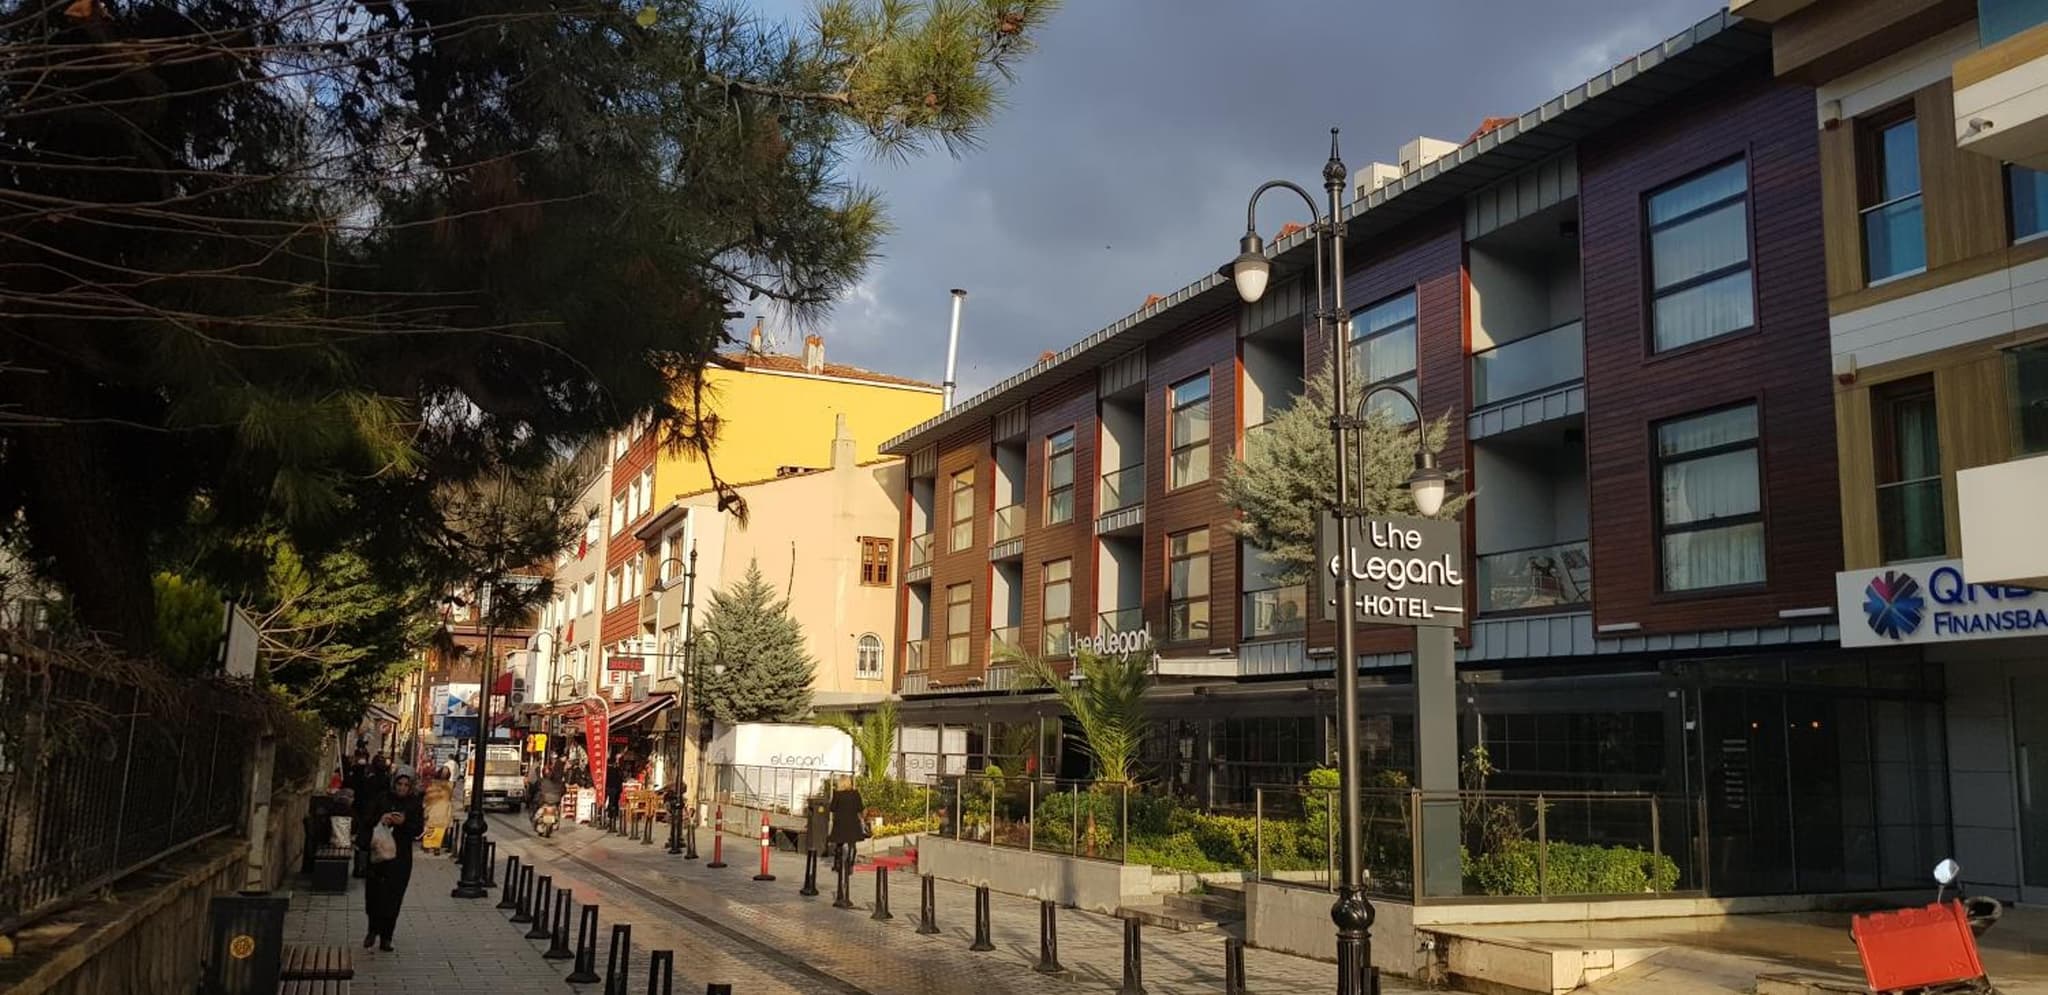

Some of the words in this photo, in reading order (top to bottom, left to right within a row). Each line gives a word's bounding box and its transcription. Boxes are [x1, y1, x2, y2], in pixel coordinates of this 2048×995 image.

[1372, 521, 1422, 550] the
[1364, 595, 1434, 618] HOTEL
[1068, 631, 1092, 657] the
[1093, 621, 1152, 663] elegant
